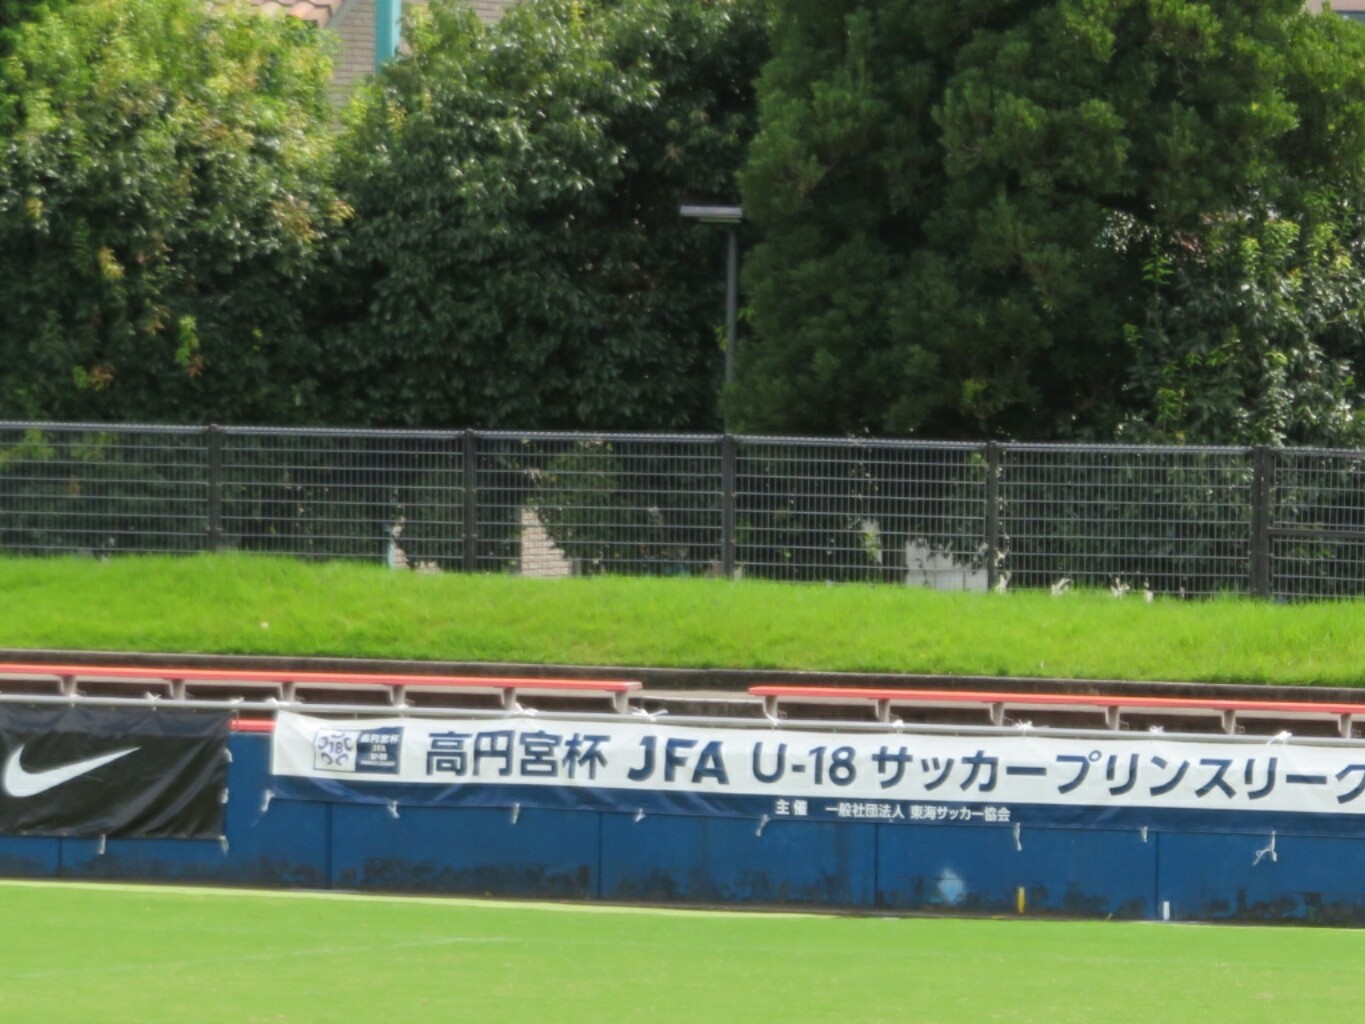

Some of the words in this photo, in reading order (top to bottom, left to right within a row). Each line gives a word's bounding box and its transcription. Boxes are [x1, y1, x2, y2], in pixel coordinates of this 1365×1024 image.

[425, 730, 608, 781] 高円宮杯
[627, 735, 728, 787] JFA
[751, 743, 857, 788] U-18
[775, 799, 809, 816] 主催
[825, 803, 906, 820] 一般社団法人
[909, 804, 1011, 823] 東海サッカー協会
